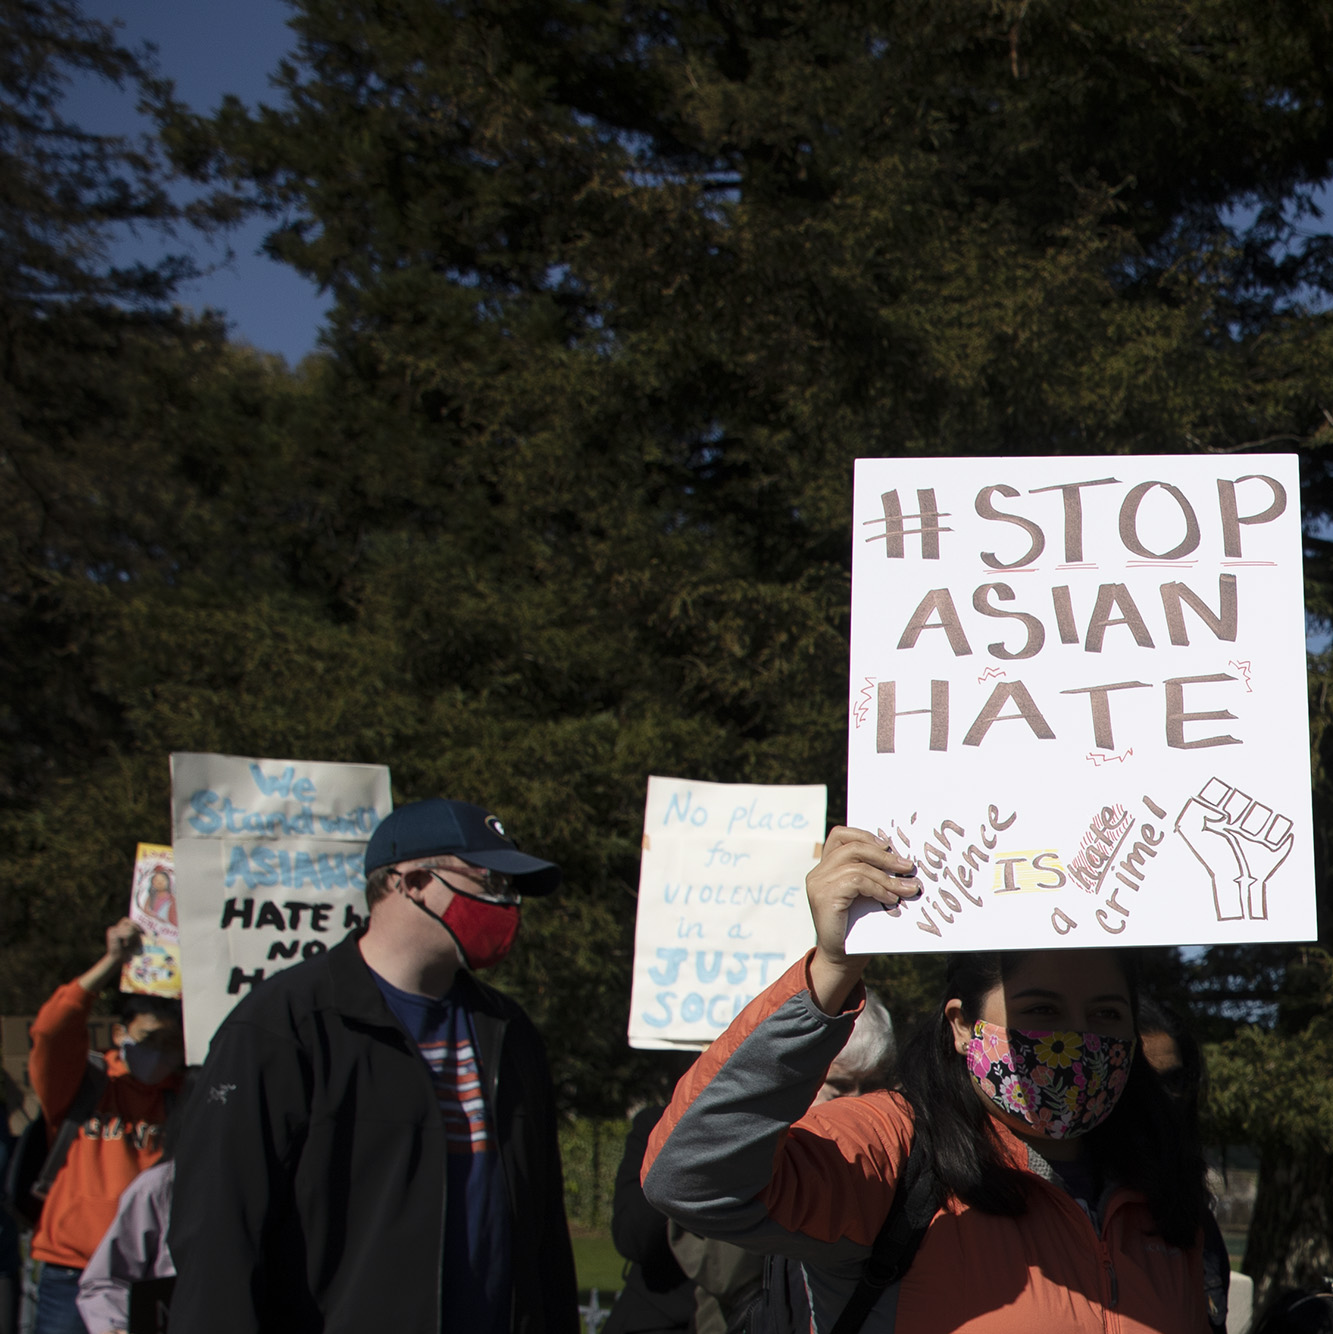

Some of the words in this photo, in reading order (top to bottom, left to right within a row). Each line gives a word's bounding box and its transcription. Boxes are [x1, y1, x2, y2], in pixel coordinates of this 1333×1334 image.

[863, 475, 1287, 569] #STOP
[896, 573, 1237, 660] ASIAN
[876, 673, 1243, 754] HATE
[249, 762, 317, 803] We
[188, 789, 316, 835] Stand
[662, 791, 708, 827] No
[727, 799, 809, 836] place
[225, 845, 366, 890] ASIANS
[704, 840, 750, 867] for
[916, 804, 1017, 937] violence
[994, 853, 1066, 893] IS
[1051, 907, 1077, 935] a
[1067, 806, 1128, 890] hate
[220, 897, 334, 932] HATE
[663, 883, 800, 908] VIOLENCE
[677, 917, 704, 939] in
[728, 922, 752, 939] a
[647, 947, 786, 986] JUST
